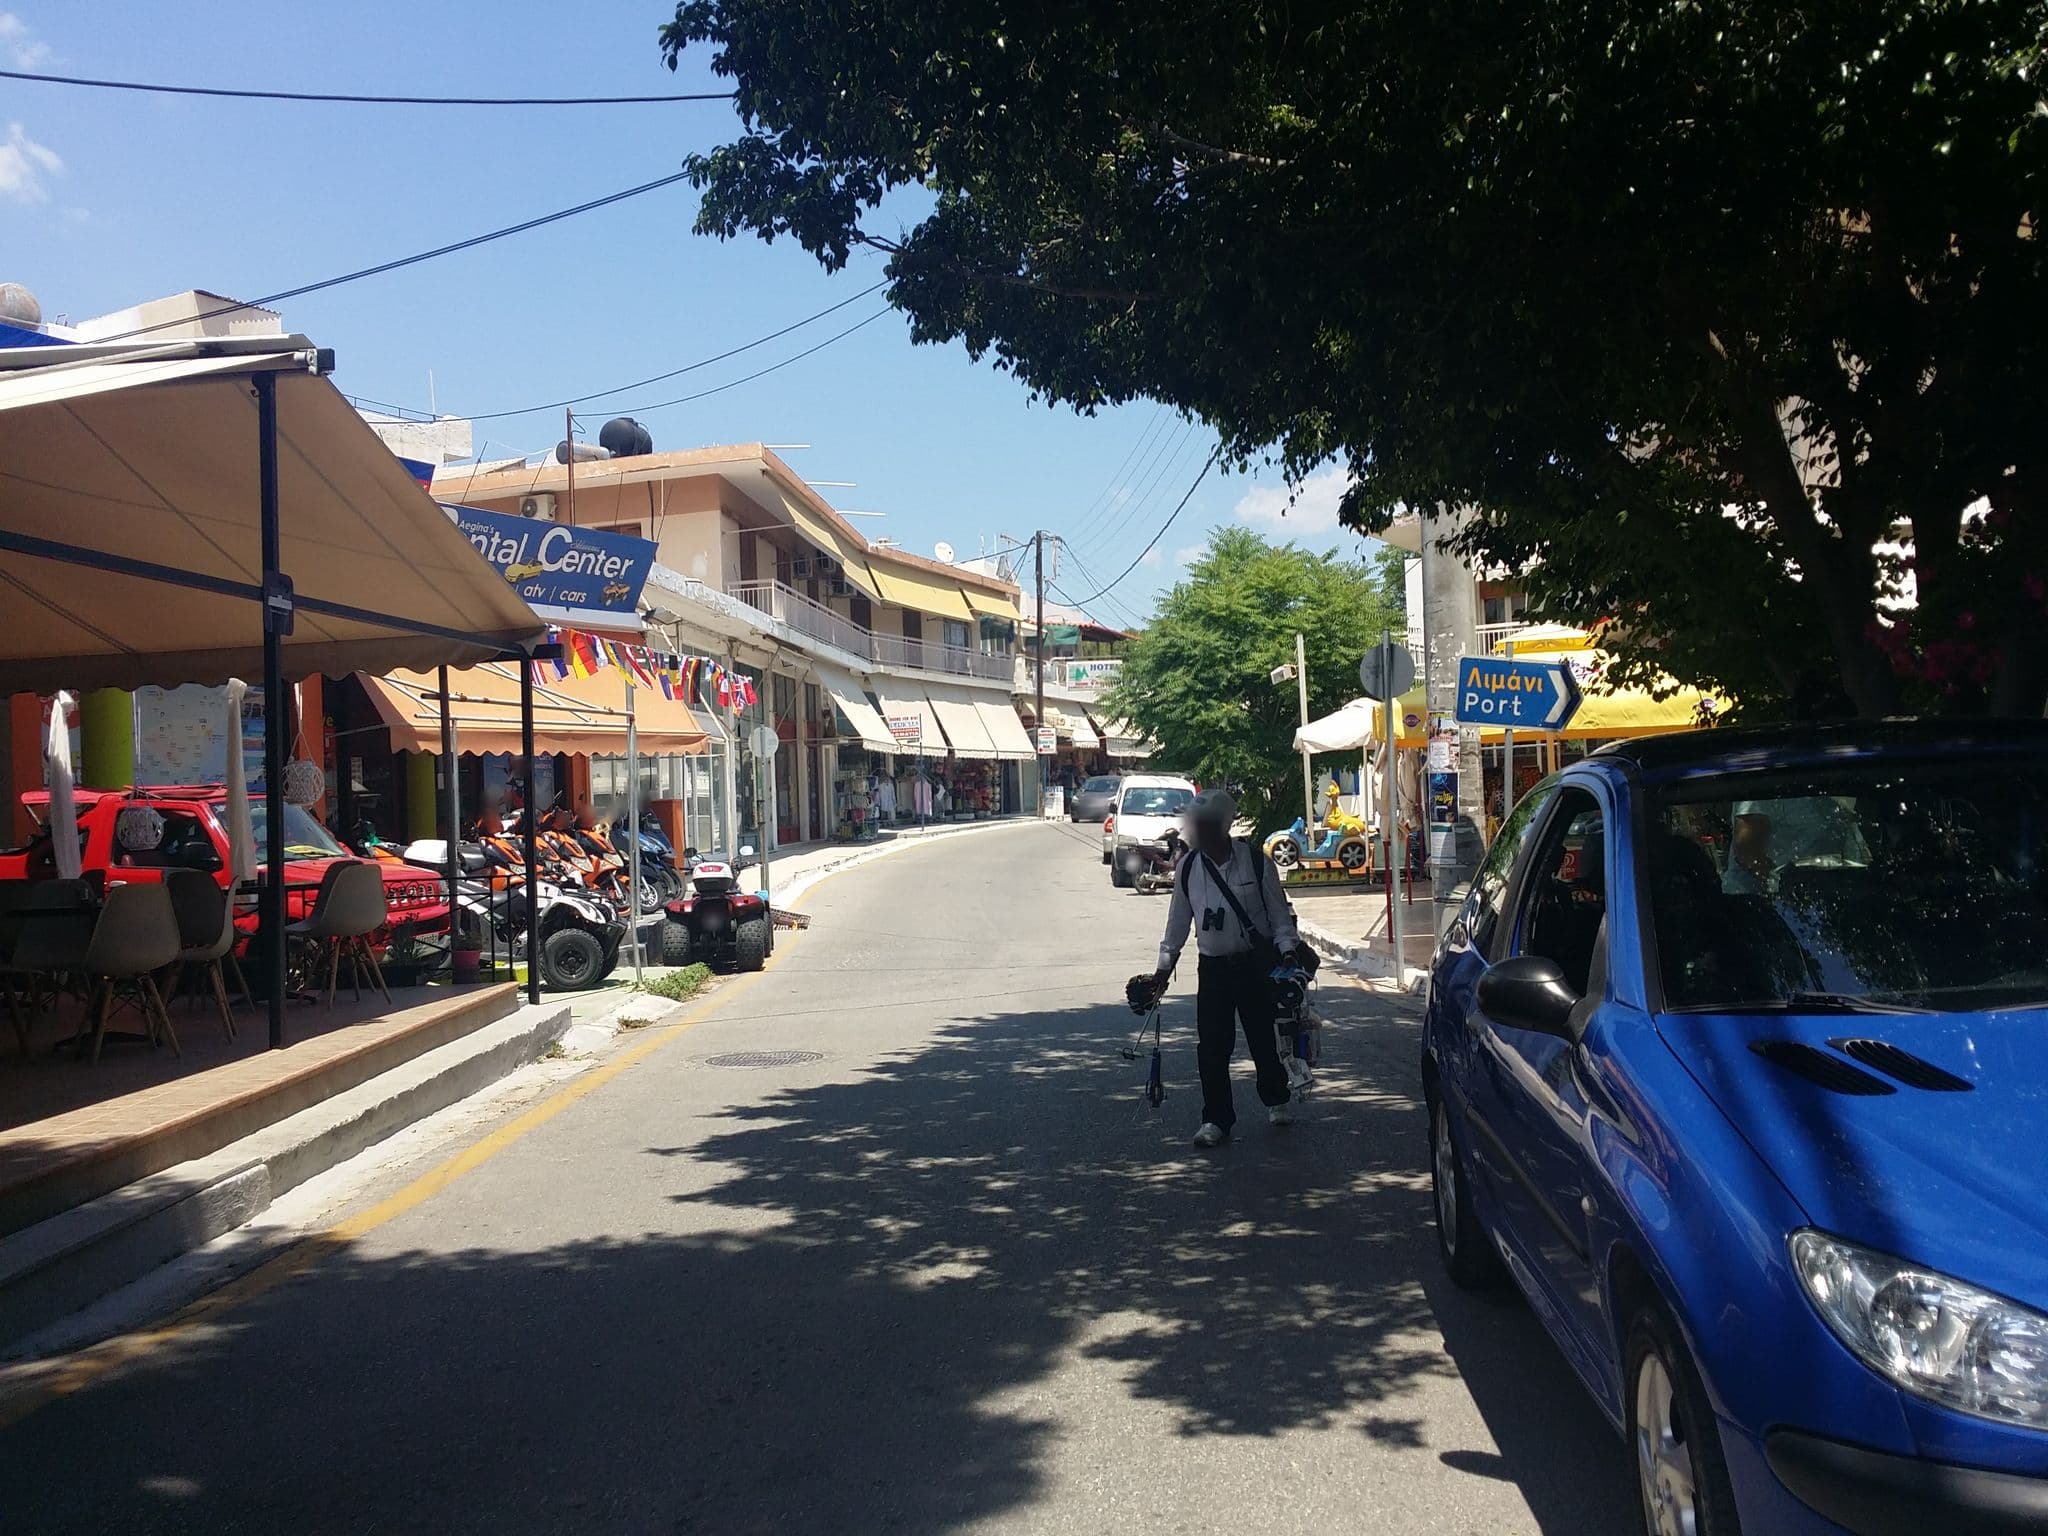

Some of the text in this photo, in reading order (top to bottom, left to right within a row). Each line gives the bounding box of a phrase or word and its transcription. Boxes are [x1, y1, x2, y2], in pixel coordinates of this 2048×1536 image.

[459, 519, 496, 534] Aegina's
[538, 526, 635, 580] Center
[524, 584, 546, 600] atv
[560, 589, 588, 603] cars
[1467, 667, 1543, 693] Λιμάνι
[1464, 692, 1522, 717] Port
